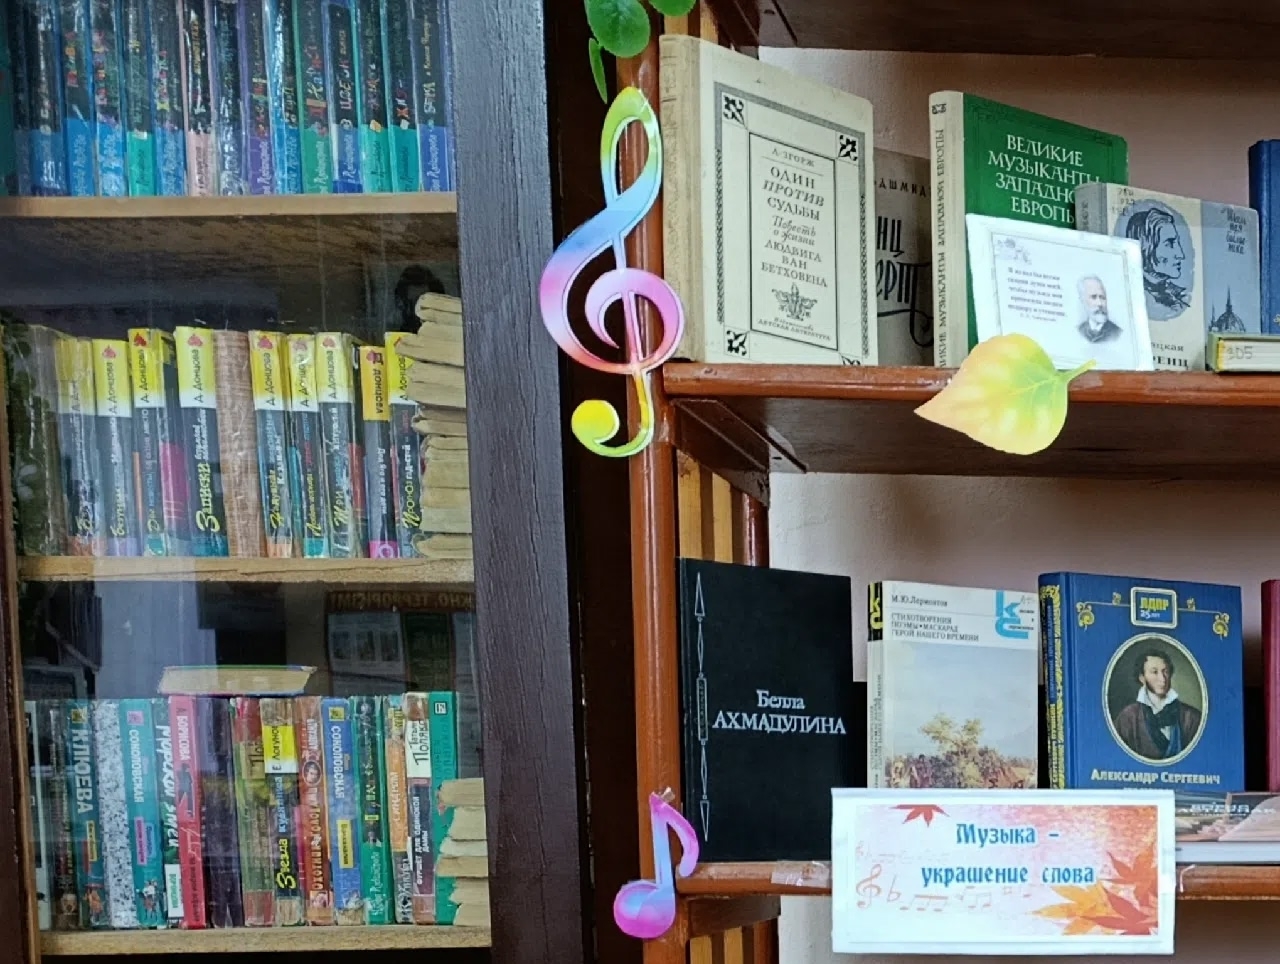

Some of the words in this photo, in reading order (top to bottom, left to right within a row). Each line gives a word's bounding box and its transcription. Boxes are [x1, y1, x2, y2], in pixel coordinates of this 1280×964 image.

[935, 129, 945, 177] ЕВРОПЫ
[1007, 134, 1083, 166] ВЕЛИКИЕ
[770, 166, 815, 189] ОДИН
[762, 179, 824, 207] ПРОТИВ
[767, 196, 820, 221] СУДЬБЫ
[764, 239, 822, 262] ЛЮДВИГА
[781, 254, 807, 269] ВАН
[761, 262, 828, 288] БЕТХОВЕНА
[937, 252, 947, 328] МУЗЫКАНТЫ
[756, 689, 805, 710] Белла
[713, 711, 846, 735] АХМАДУЛИНА
[176, 715, 190, 761] БОРИСОВА
[71, 728, 93, 814] КЛЮЕВА
[129, 729, 143, 803] СОКОЛОВСКАЯ
[331, 726, 344, 798] СОКОЛОВСКАЯ
[956, 823, 1036, 847] Музыка
[921, 863, 1029, 888] украшение
[1041, 864, 1095, 886] слова
